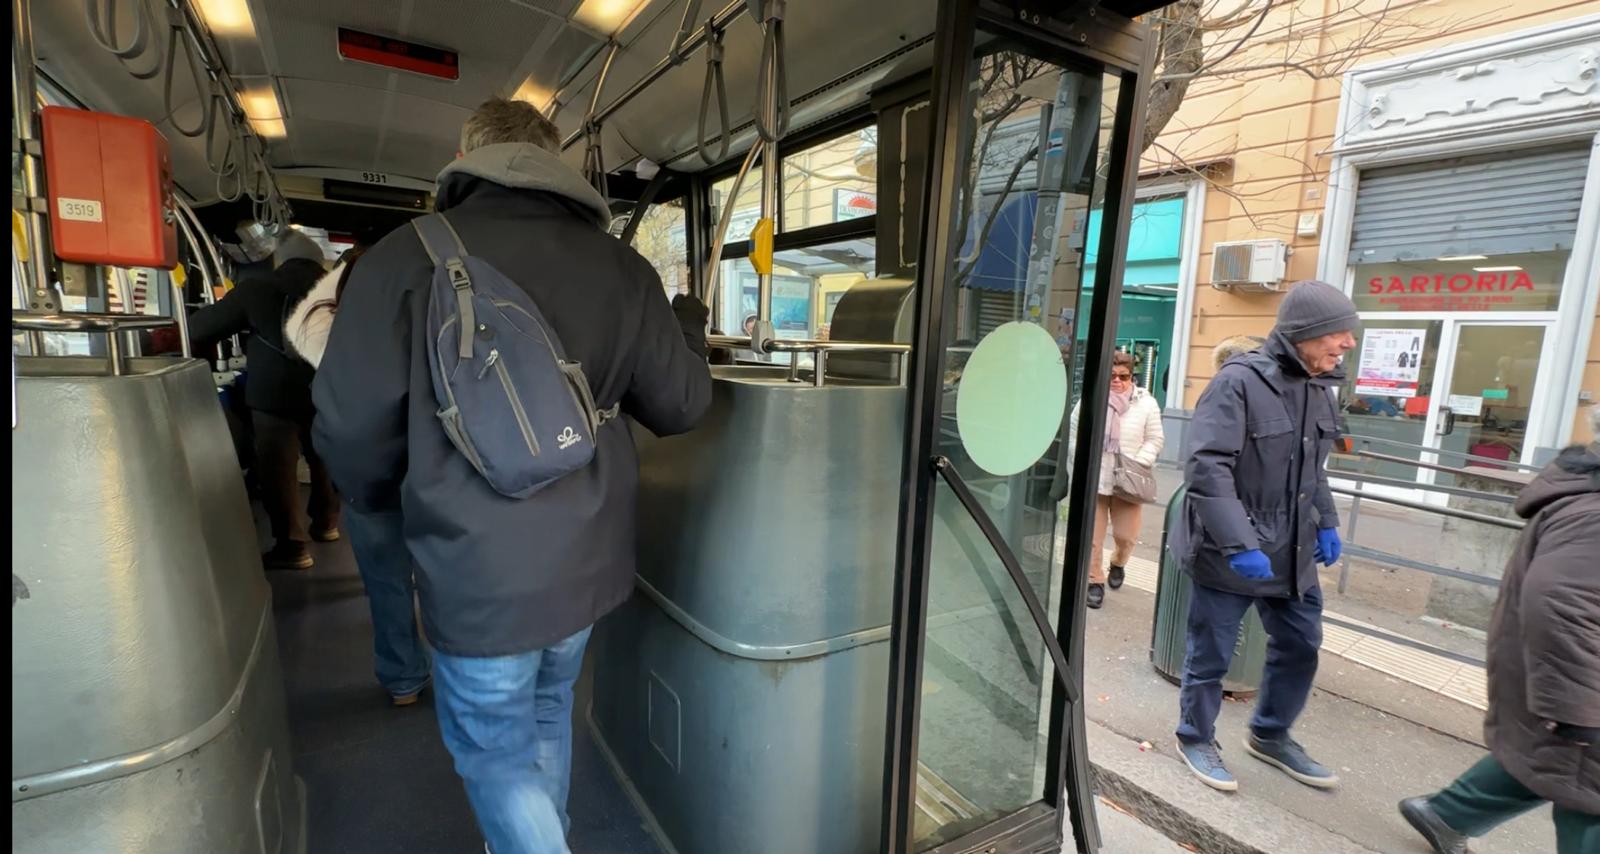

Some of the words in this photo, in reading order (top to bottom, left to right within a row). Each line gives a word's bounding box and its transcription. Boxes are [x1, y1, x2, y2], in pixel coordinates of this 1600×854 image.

[362, 172, 386, 183] 9331
[65, 203, 94, 216] 3519
[1368, 271, 1535, 294] SARTORIA
